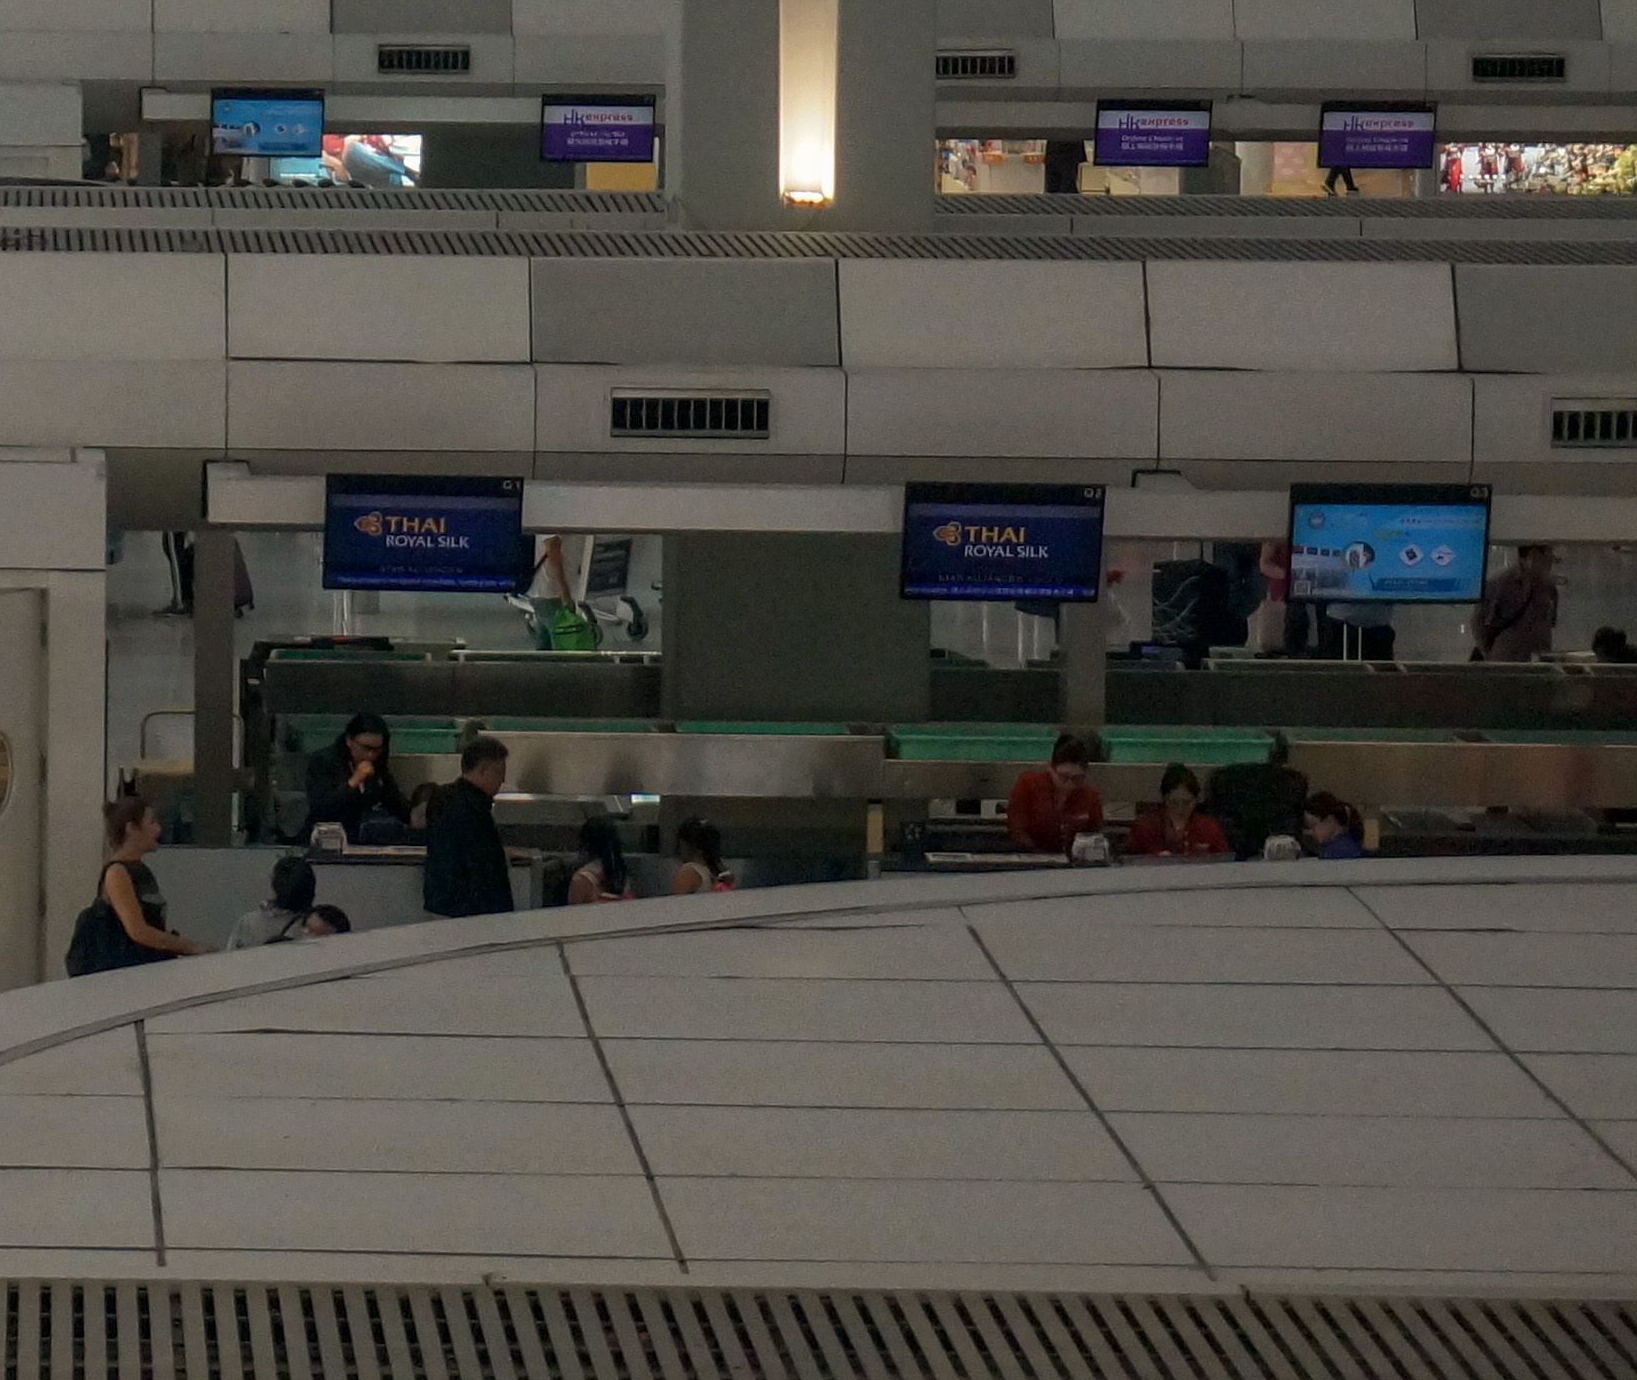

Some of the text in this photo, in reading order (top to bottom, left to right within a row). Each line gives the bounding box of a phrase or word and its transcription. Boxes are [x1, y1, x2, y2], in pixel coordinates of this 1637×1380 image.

[386, 516, 447, 533] THAI
[386, 534, 470, 548] ROYAL SILK
[964, 526, 1025, 543] THAI
[964, 544, 1049, 558] ROYAL SILK
